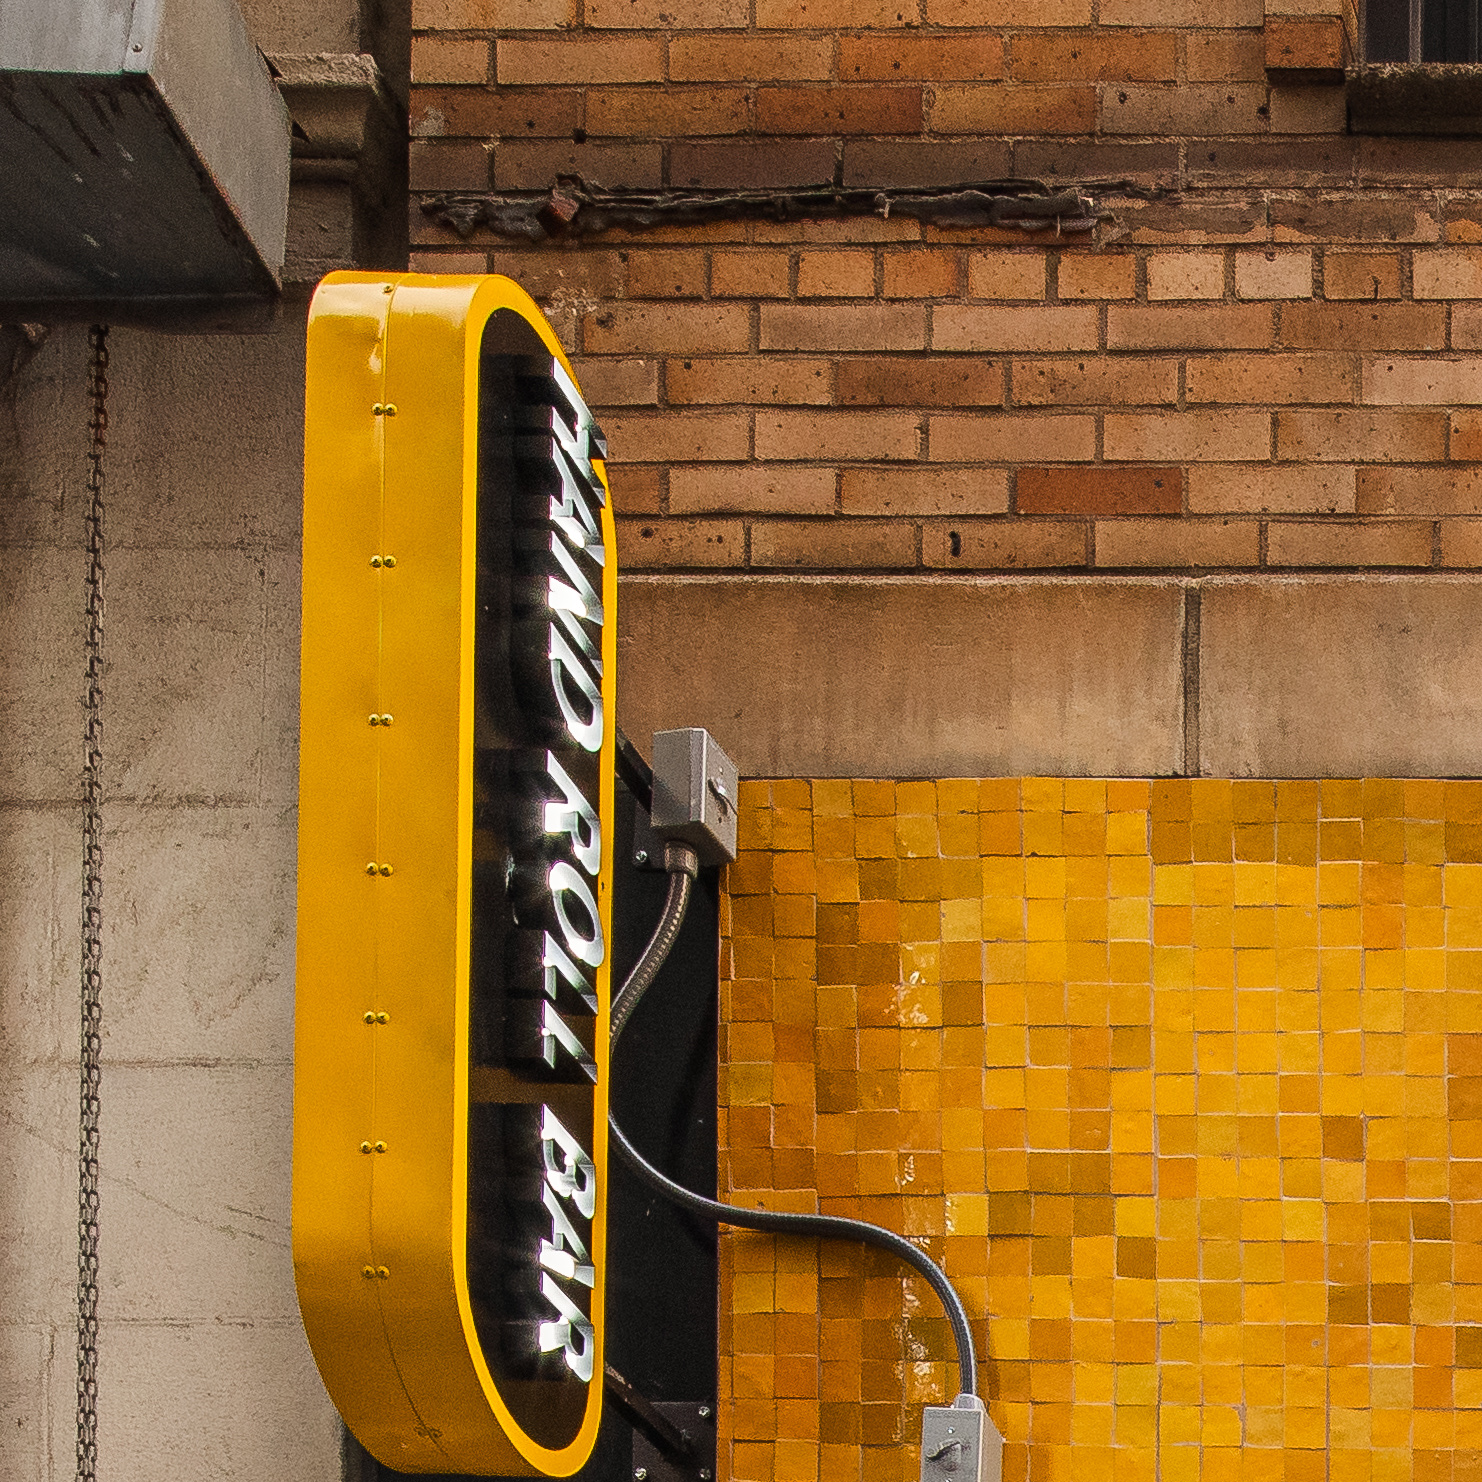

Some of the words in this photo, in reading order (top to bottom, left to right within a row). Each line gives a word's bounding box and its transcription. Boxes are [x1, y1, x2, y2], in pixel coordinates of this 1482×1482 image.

[548, 355, 607, 753] HAND
[543, 749, 604, 1086] ROLL
[538, 1103, 596, 1383] BAR
